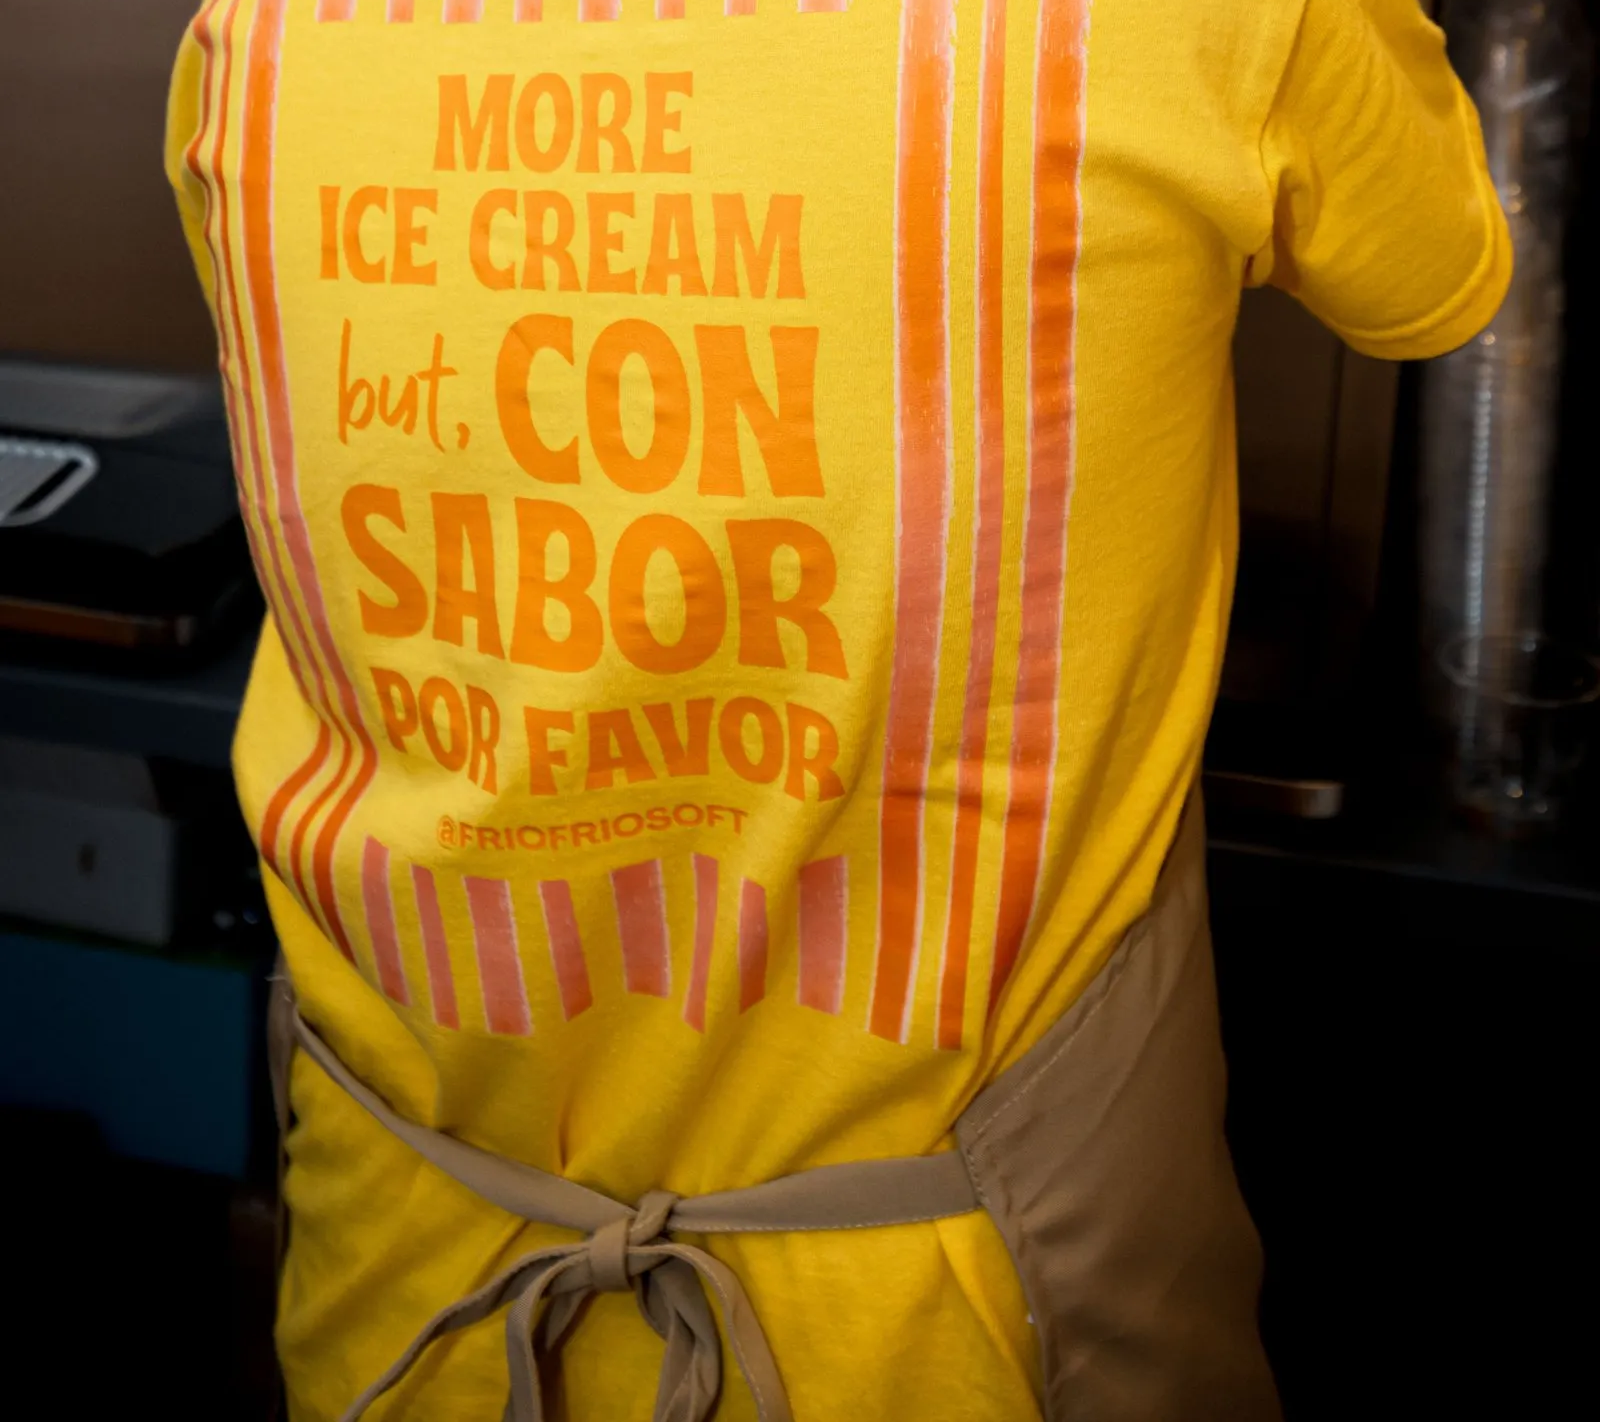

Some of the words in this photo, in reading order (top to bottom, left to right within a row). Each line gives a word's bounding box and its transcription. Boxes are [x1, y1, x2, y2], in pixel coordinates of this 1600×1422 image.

[433, 71, 694, 174] MORE
[318, 185, 438, 287] ICE
[468, 188, 806, 300] CREAM
[337, 317, 471, 454] but,
[495, 313, 826, 498] CON
[340, 483, 850, 680] SABOR
[369, 666, 501, 796] POR
[522, 696, 846, 803] FAVOR
[437, 803, 748, 851] @FRIOFRIOSOFT
